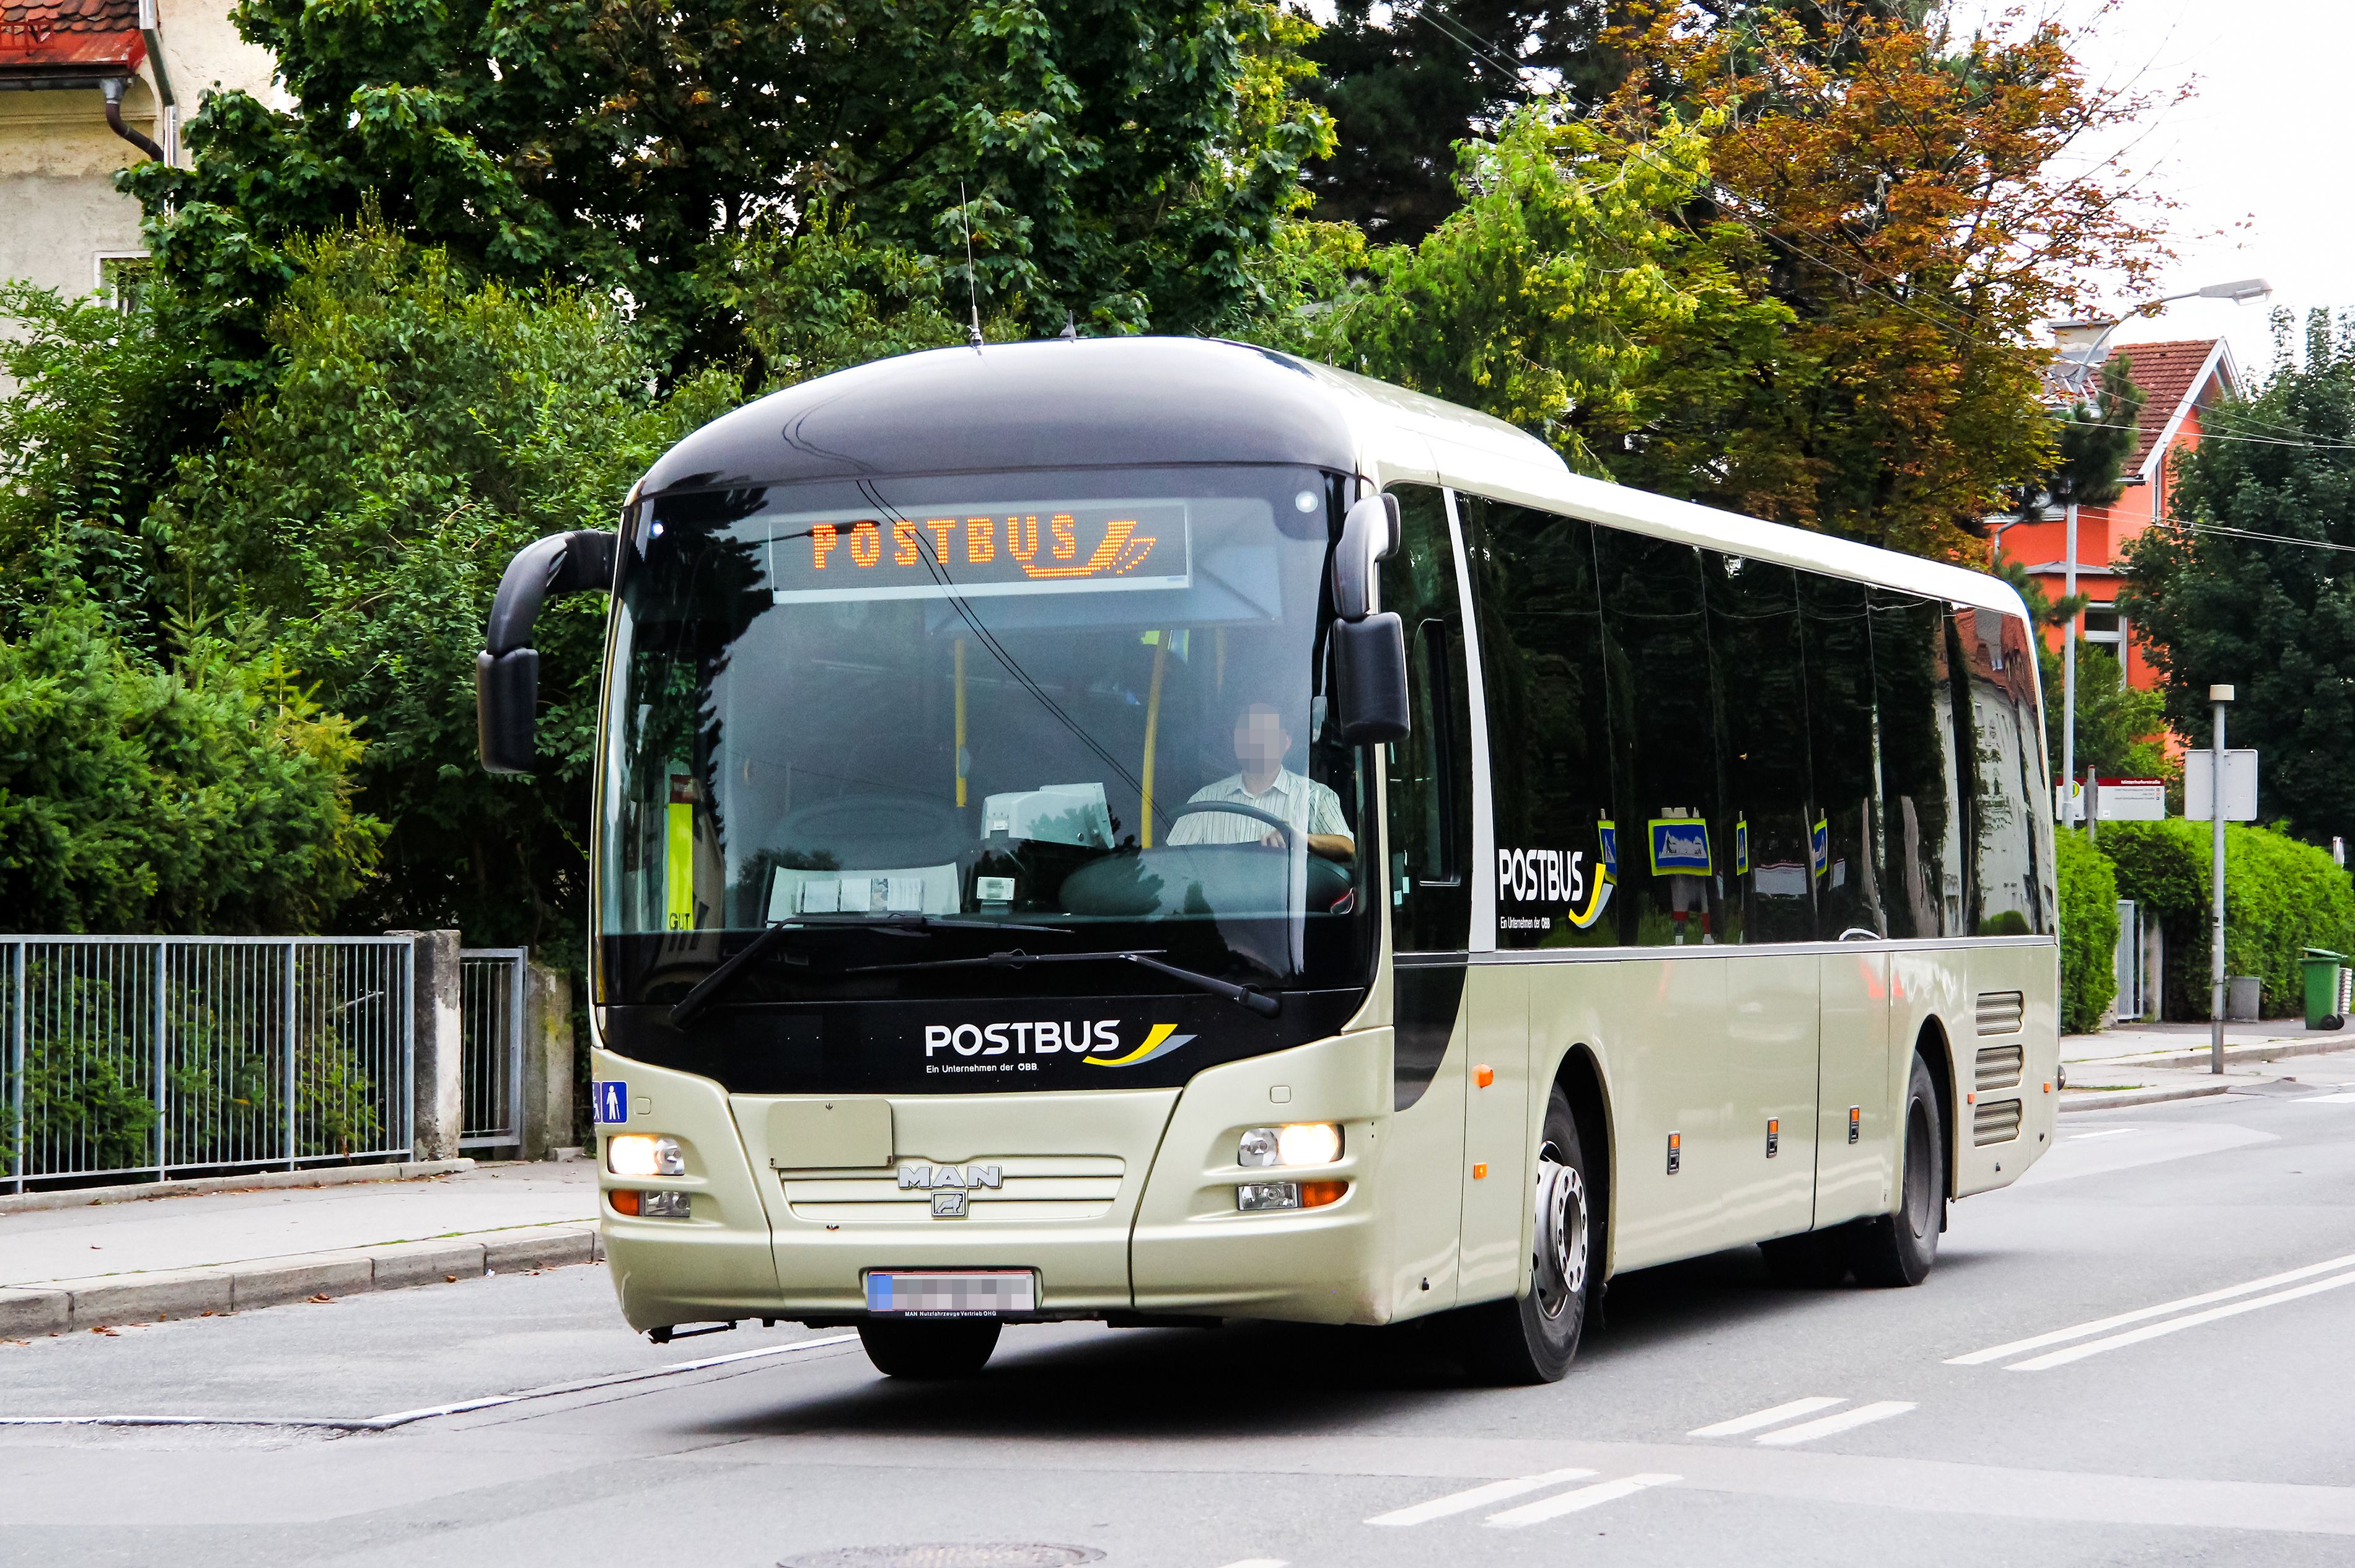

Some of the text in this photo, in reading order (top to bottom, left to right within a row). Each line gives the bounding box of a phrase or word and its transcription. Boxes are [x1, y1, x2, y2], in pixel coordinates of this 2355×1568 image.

[812, 514, 1075, 570] POSTBUS
[1499, 848, 1583, 902] POSTBUS
[669, 912, 690, 930] GUT
[1508, 916, 1533, 929] Unternehmen
[925, 1020, 1120, 1057] POSTBUS
[926, 1065, 940, 1073] Ein
[942, 1064, 997, 1073] Unternehmen
[1000, 1063, 1014, 1072] der
[898, 1166, 1001, 1189] MAN
